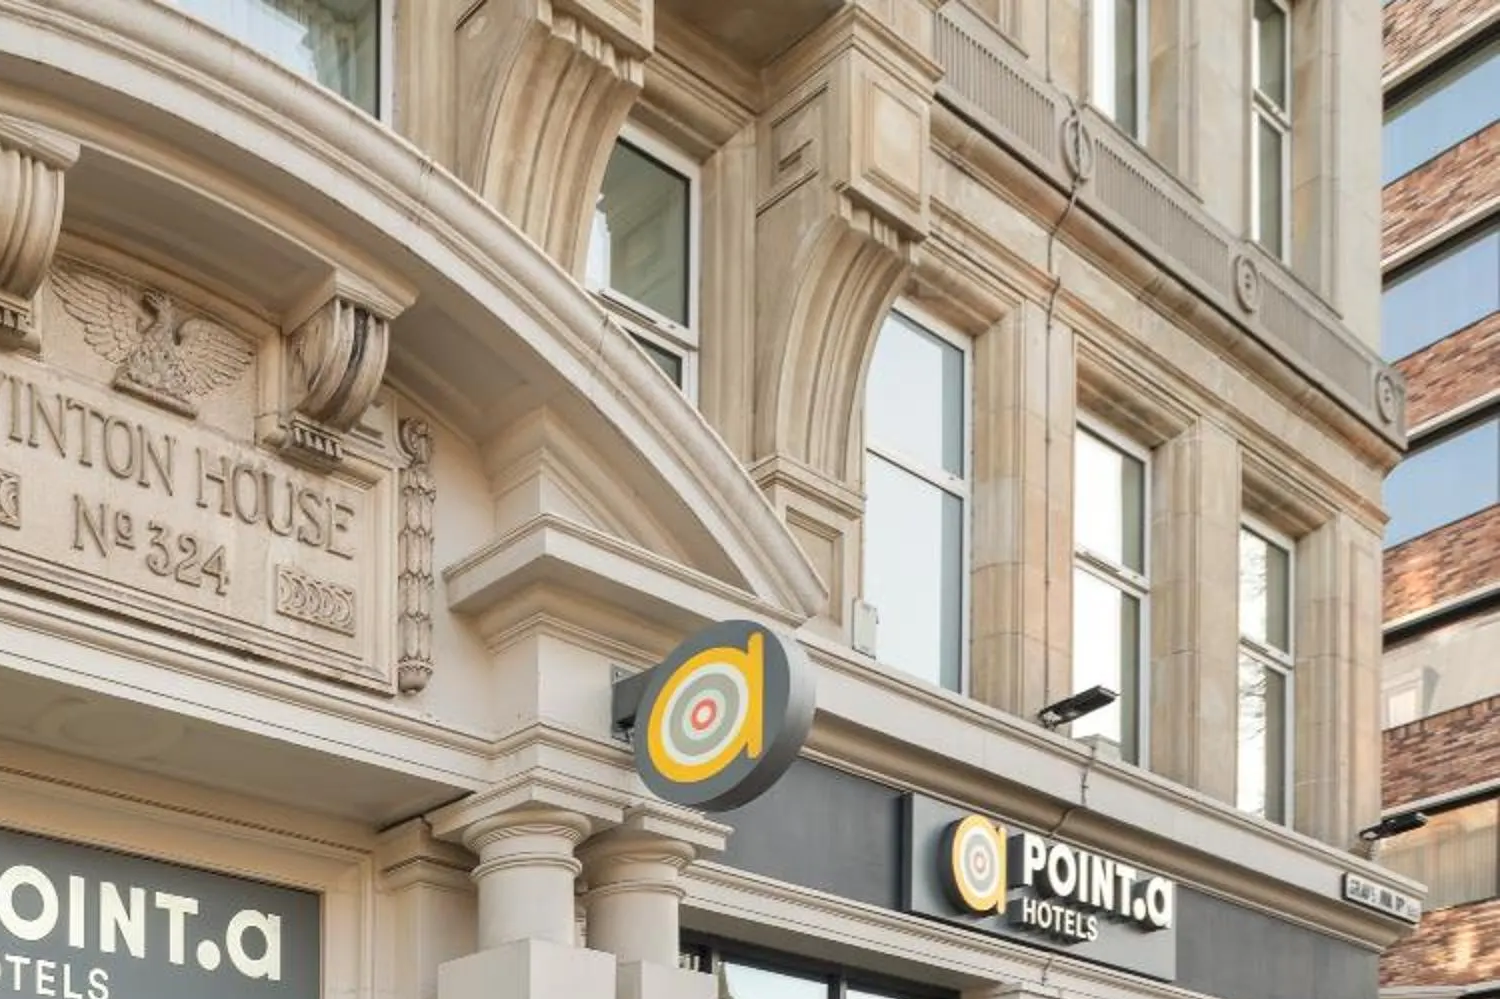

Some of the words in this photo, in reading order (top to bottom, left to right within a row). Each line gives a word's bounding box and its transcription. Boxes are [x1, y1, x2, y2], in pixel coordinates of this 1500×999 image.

[196, 446, 355, 559] HOUSE
[147, 520, 231, 596] 324
[1022, 896, 1099, 942] HOTELS
[1023, 832, 1174, 929] POINT.a
